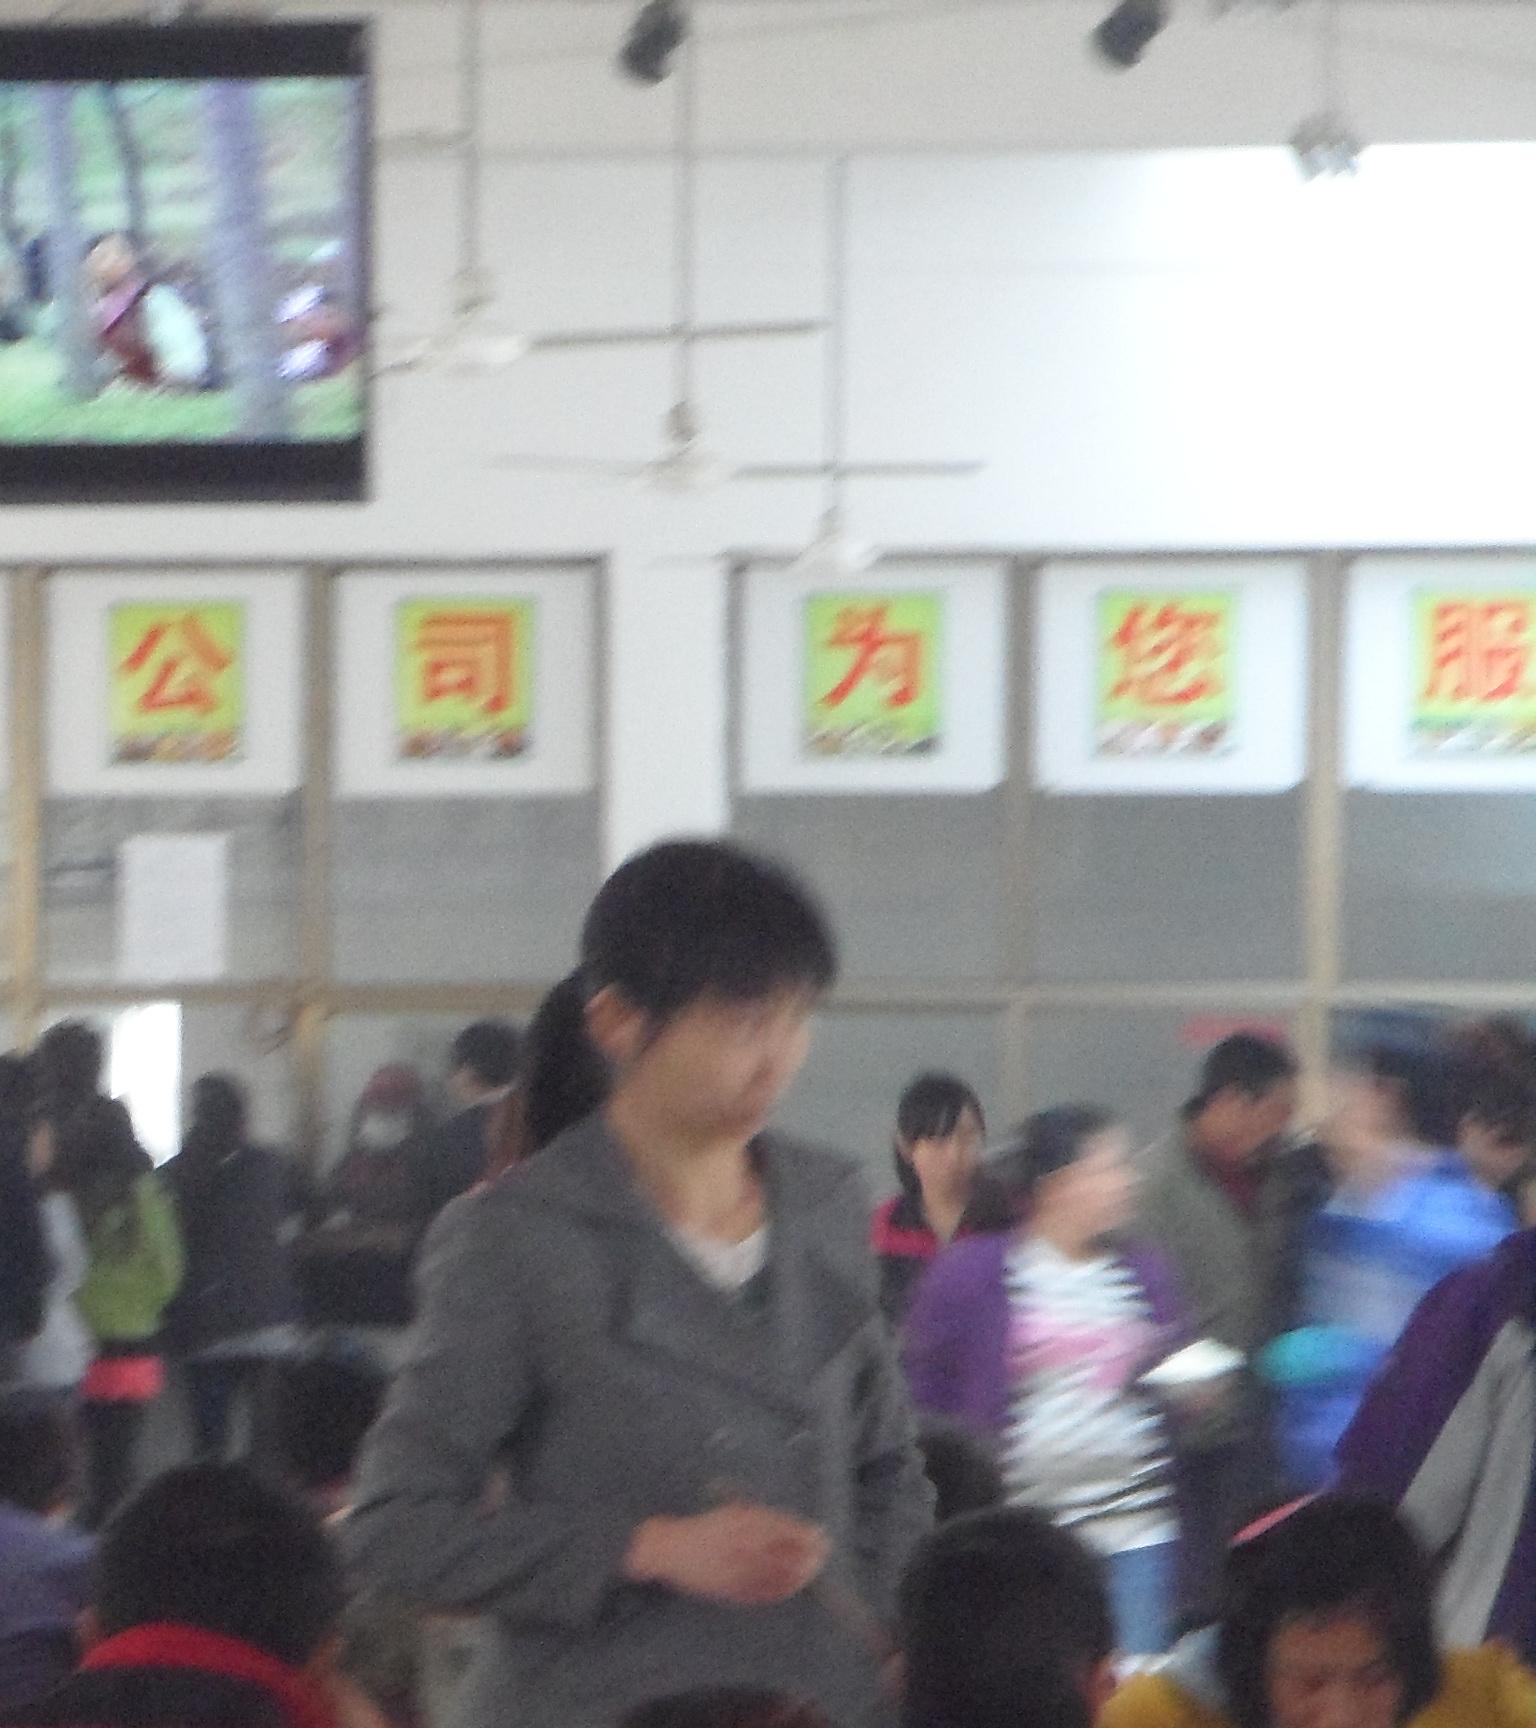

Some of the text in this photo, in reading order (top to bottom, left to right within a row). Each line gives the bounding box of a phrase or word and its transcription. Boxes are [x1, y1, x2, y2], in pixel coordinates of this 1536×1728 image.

[120, 613, 232, 713] 公
[420, 612, 514, 714] 司
[821, 604, 923, 708] 为
[1110, 602, 1223, 706] 您
[1425, 600, 1529, 702] 服
